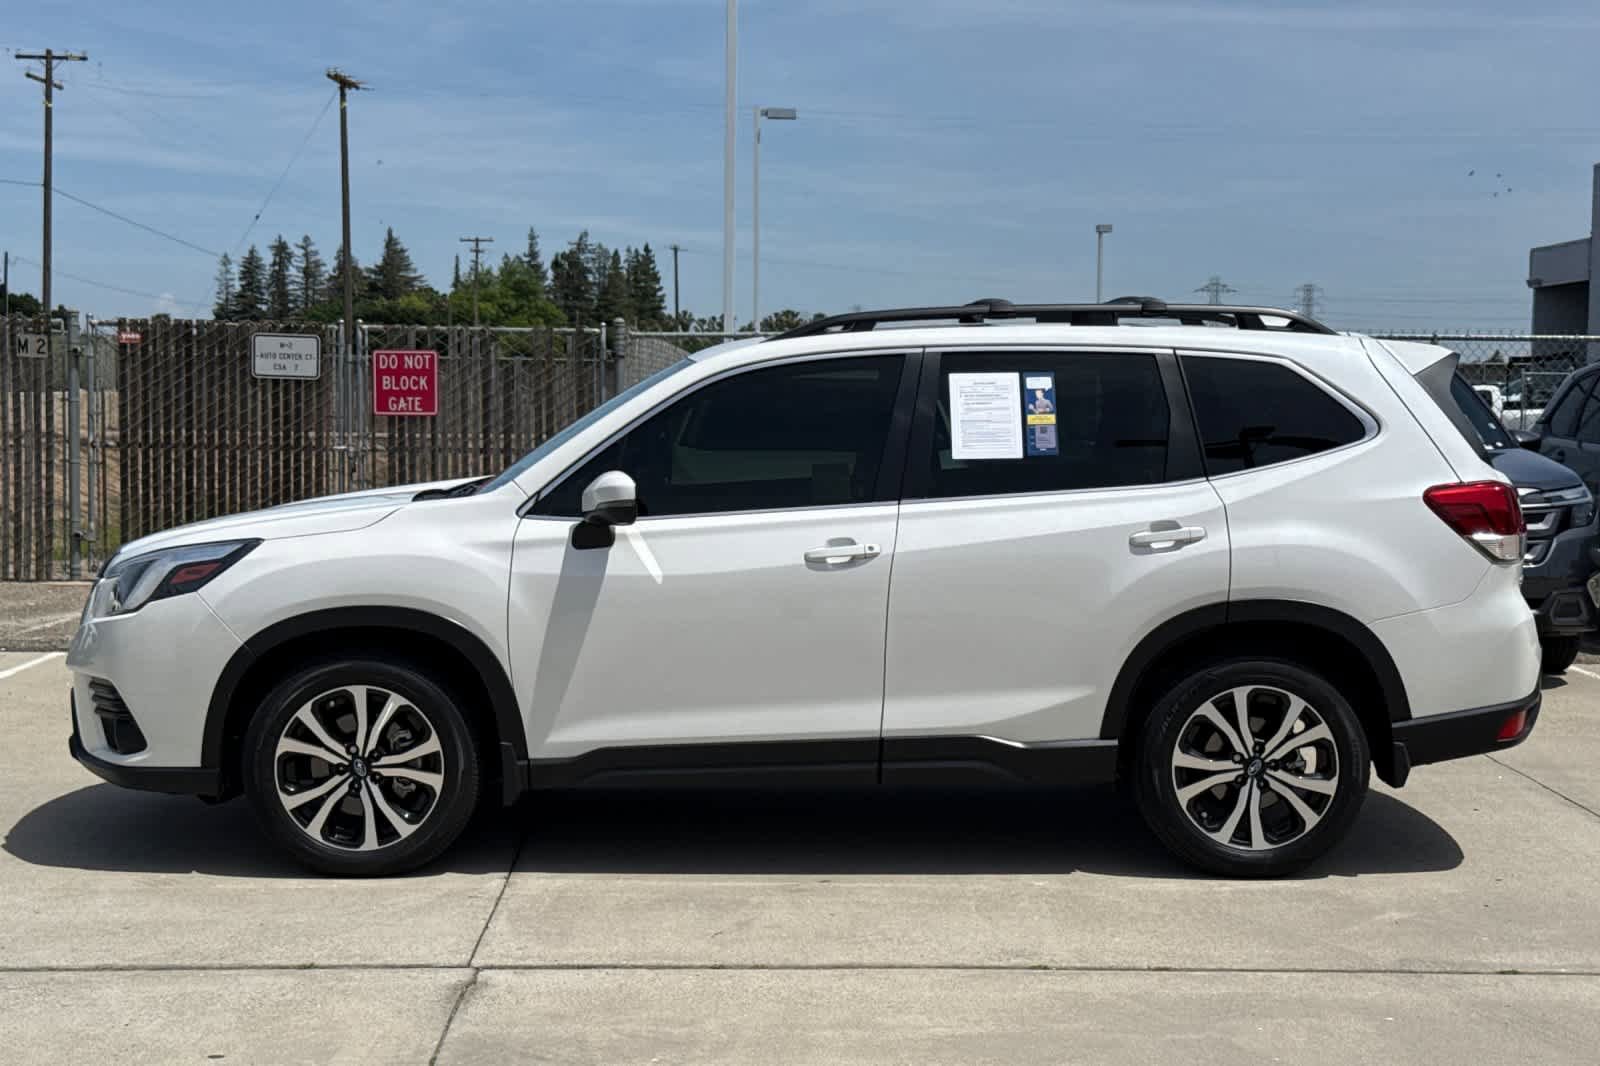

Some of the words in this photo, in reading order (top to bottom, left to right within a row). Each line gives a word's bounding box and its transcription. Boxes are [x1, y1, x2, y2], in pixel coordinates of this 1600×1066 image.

[18, 337, 29, 353] M
[36, 338, 46, 354] 2
[260, 352, 277, 361] AUTO
[279, 352, 303, 361] CENTER
[379, 354, 398, 369] DO
[404, 354, 431, 369] NOT
[382, 375, 428, 391] BLOCK
[388, 396, 423, 411] GATE
